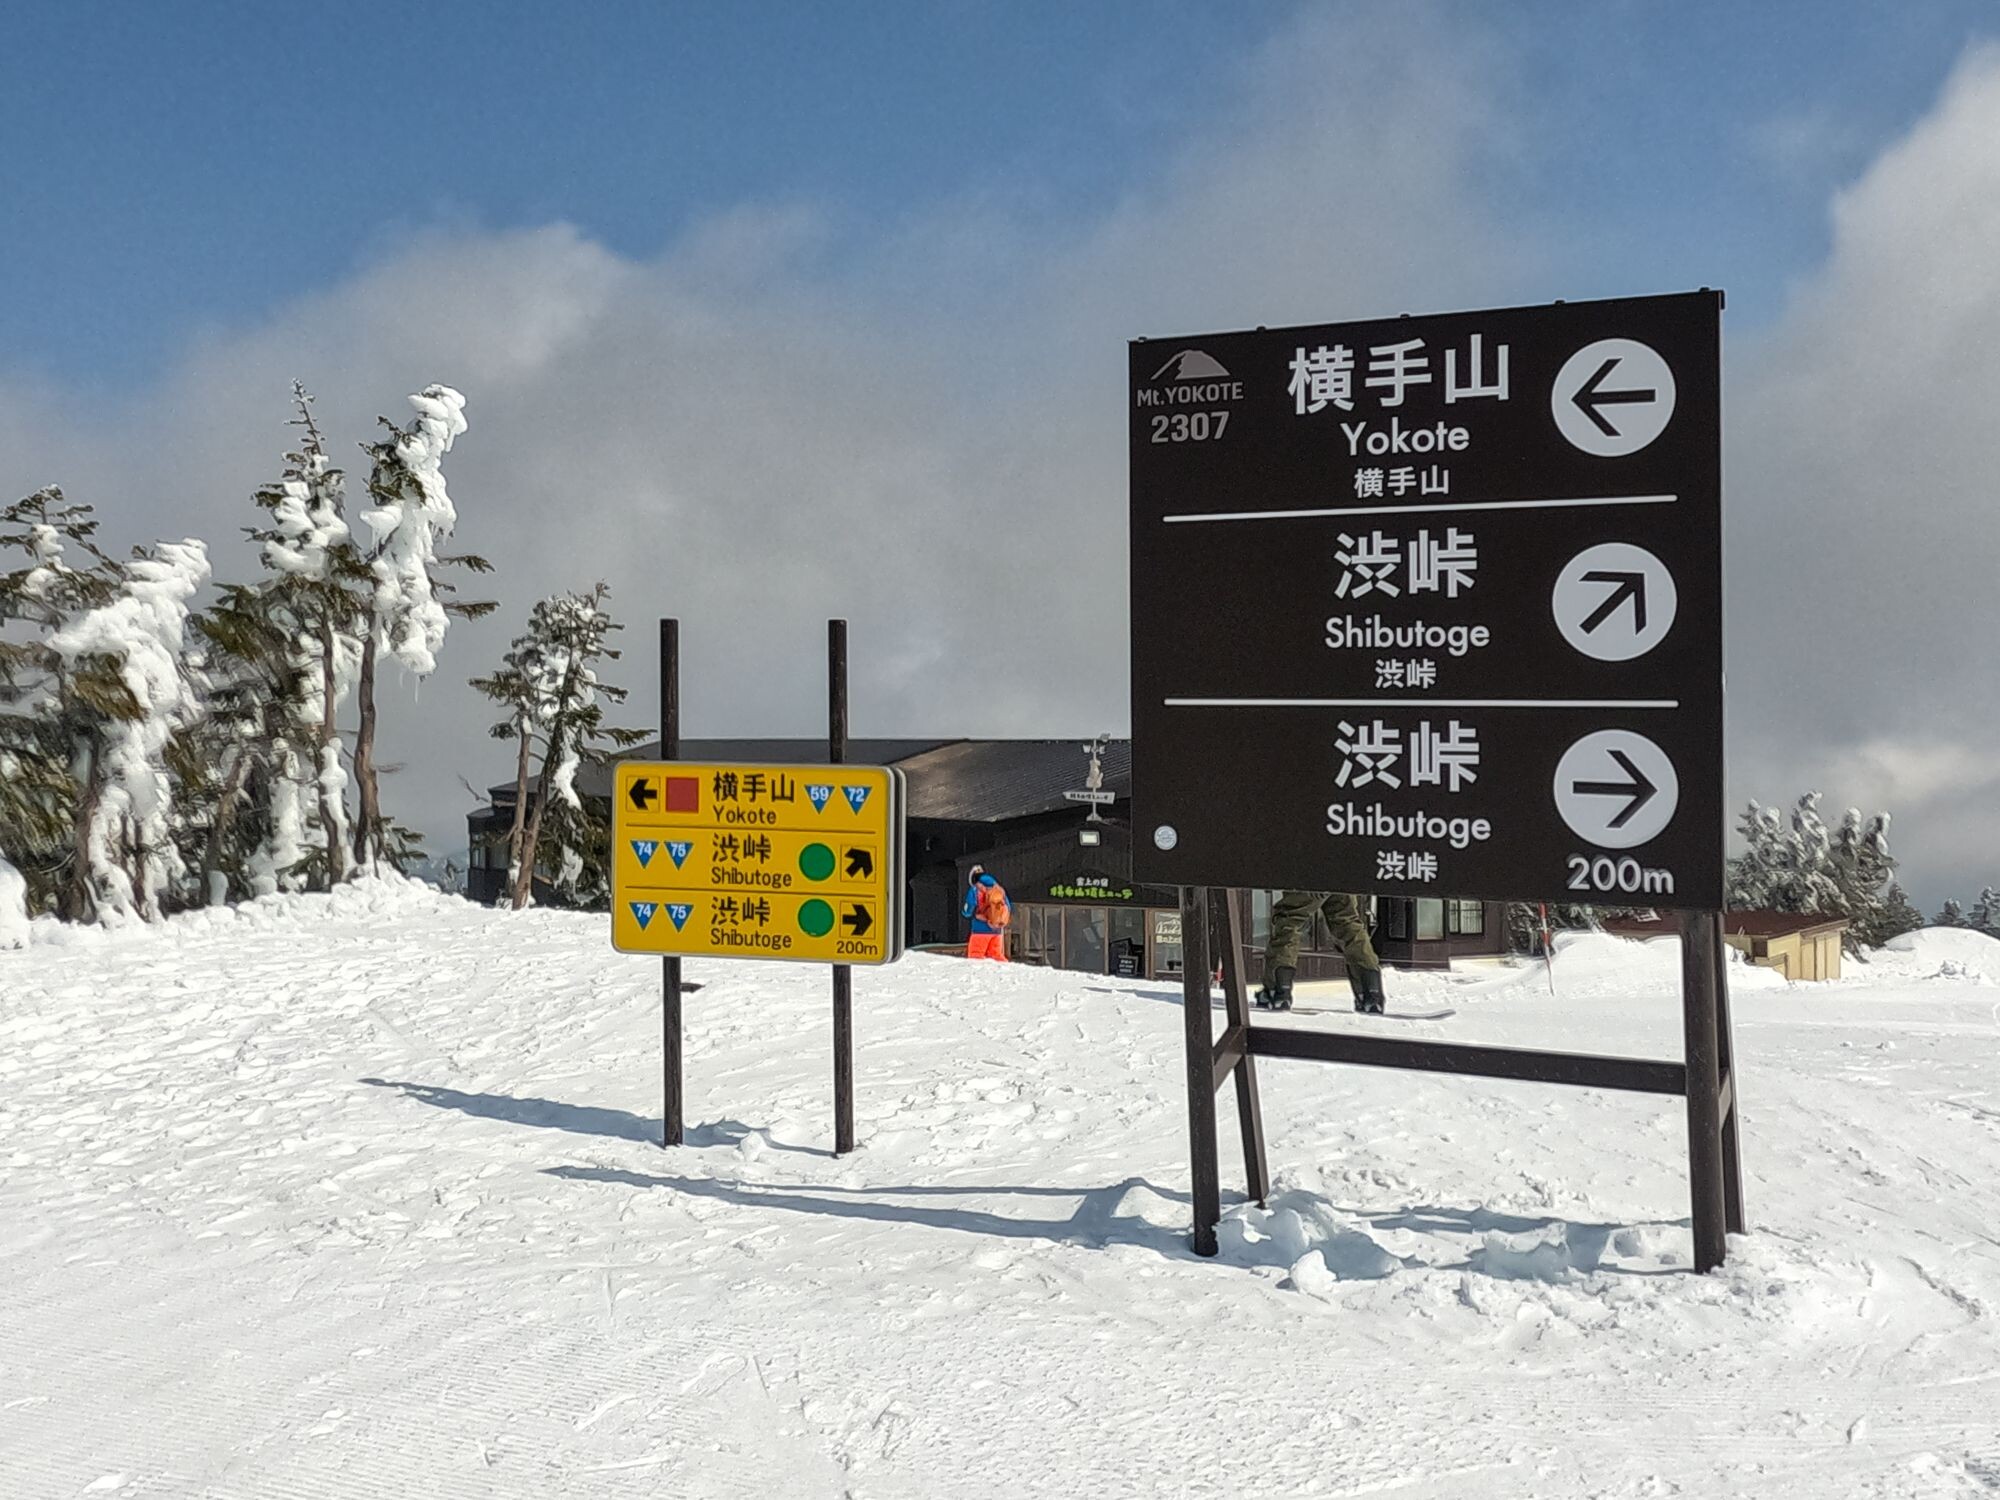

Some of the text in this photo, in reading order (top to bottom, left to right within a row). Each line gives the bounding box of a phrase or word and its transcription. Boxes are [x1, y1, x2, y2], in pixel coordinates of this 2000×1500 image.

[1287, 332, 1511, 416] 横手山
[1136, 382, 1244, 408] Mt.YOKOTE
[1151, 411, 1230, 443] 2307
[1341, 416, 1470, 456] Yokote
[1353, 464, 1450, 499] 横手山
[1333, 526, 1478, 600] 渋峠
[1325, 615, 1490, 657] Shibutoge
[1375, 658, 1437, 689] 渋峠
[1333, 719, 1480, 793] 渋峠
[712, 770, 795, 804] 横手山
[810, 786, 865, 803] 59 72
[712, 805, 777, 825] Yokote
[1326, 801, 1491, 849] Shibutoge
[637, 841, 652, 856] 74
[711, 832, 772, 865] 渋峠
[710, 866, 792, 888] Shibutoge
[1376, 850, 1438, 883] 渋峠
[1568, 855, 1674, 894] 200m
[636, 903, 687, 920] 74 75
[710, 895, 772, 928] 渋峠
[710, 928, 792, 950] Shibutoge
[836, 940, 878, 956] 200m
